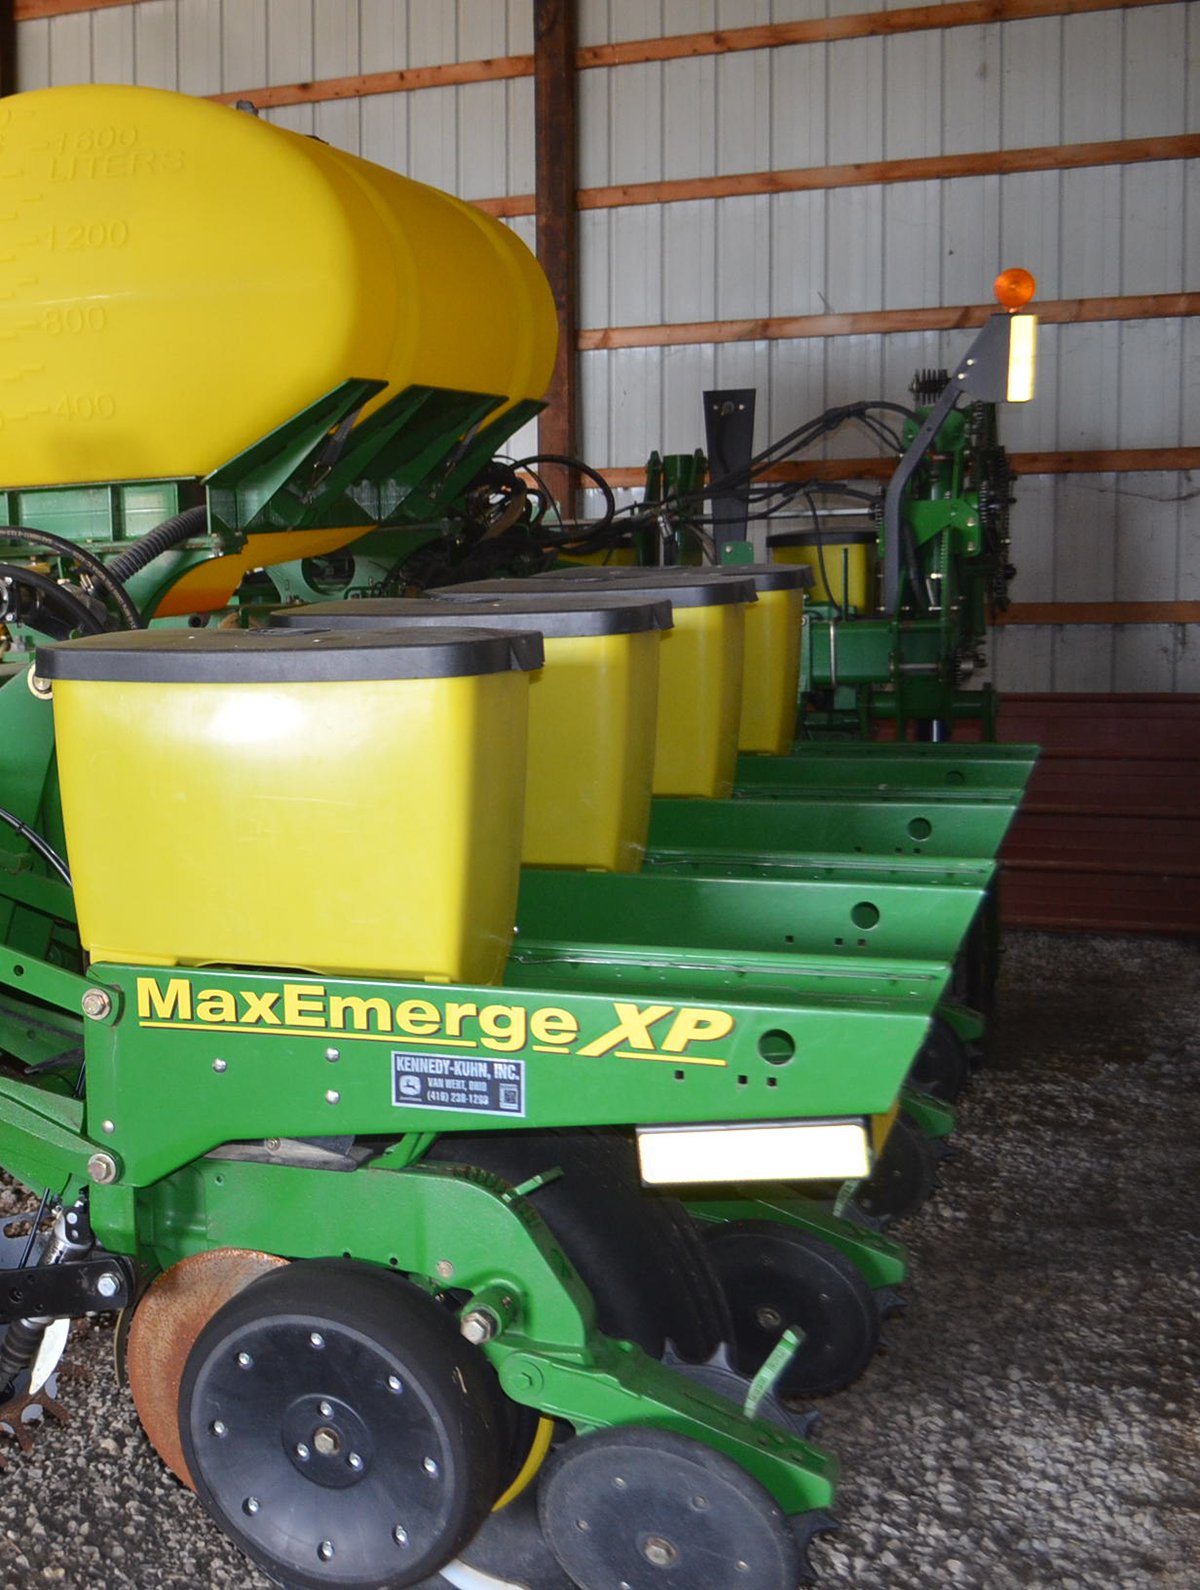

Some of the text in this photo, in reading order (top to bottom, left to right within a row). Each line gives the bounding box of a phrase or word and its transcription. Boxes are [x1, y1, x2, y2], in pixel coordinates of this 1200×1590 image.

[49, 148, 186, 183] LITERS
[48, 219, 130, 252] 1200
[43, 305, 108, 336] 800
[54, 392, 116, 421] 400
[136, 977, 736, 1057] MaxEmerge XP
[396, 1056, 520, 1080] KENNEDY-KUHN, INC.
[427, 1077, 444, 1089] VAN
